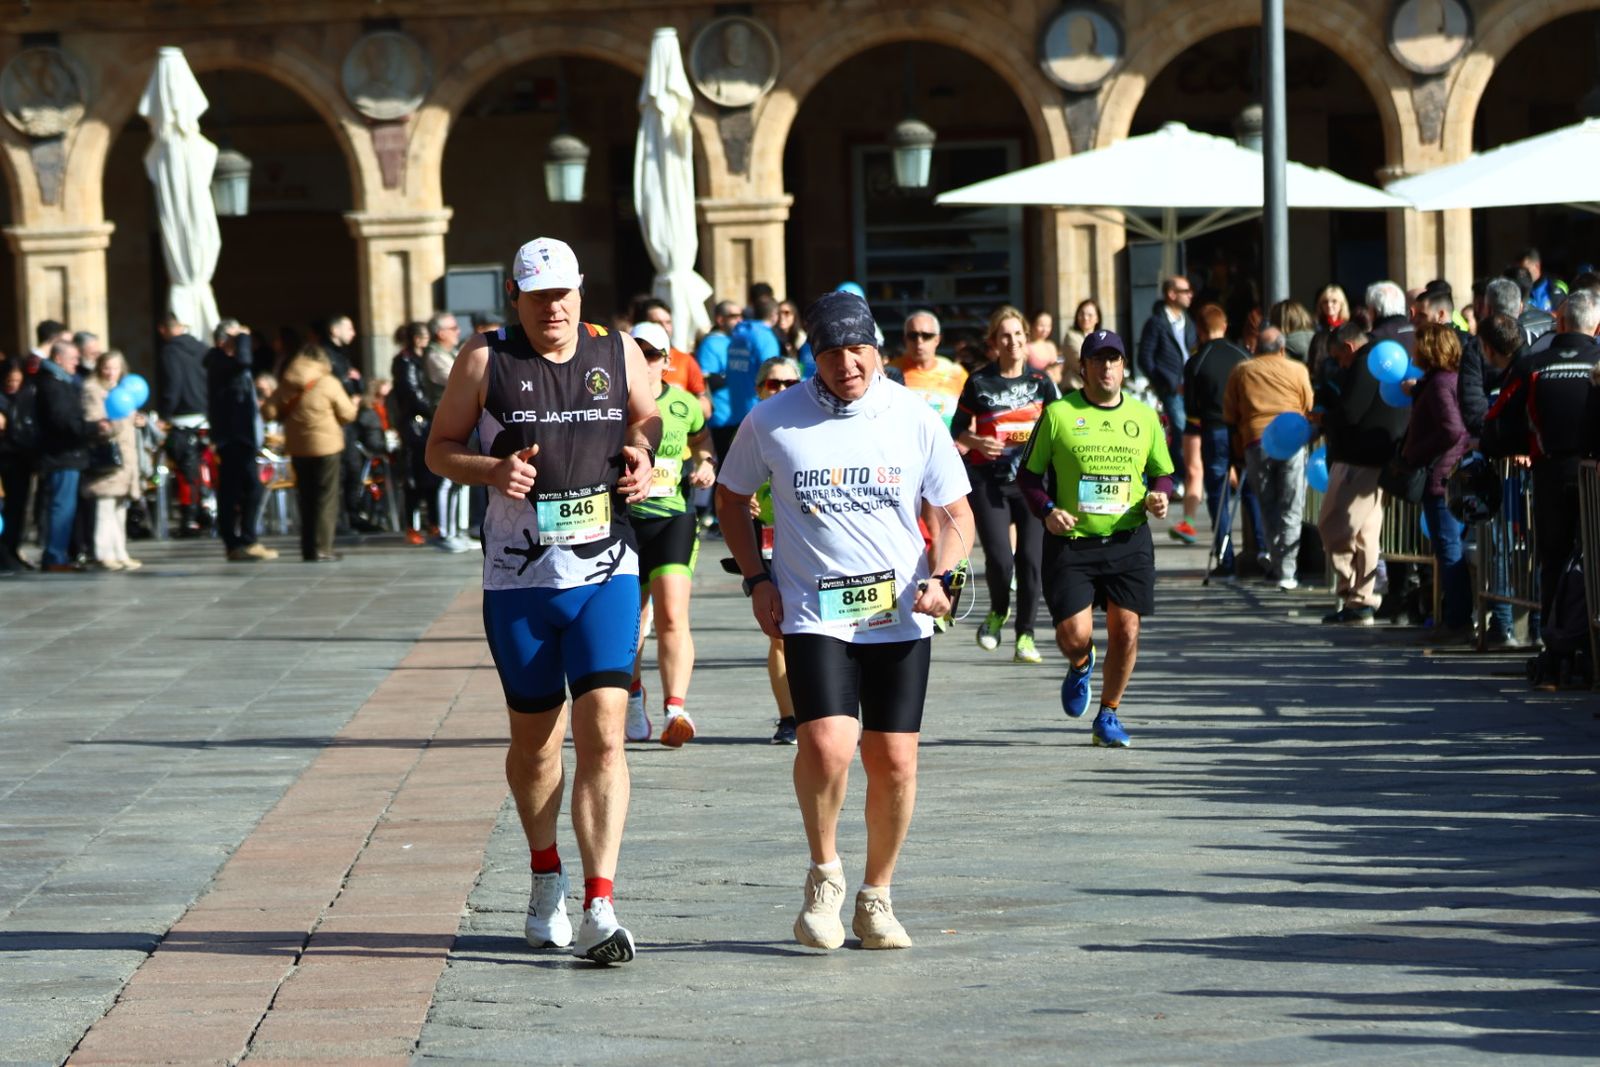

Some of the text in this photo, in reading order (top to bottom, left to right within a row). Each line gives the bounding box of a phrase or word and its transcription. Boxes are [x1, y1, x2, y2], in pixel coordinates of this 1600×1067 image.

[502, 407, 623, 424] LOS JARTIBLES
[1071, 445, 1141, 456] CORRECAMINOS
[1080, 455, 1133, 464] CARBAJOSA
[1088, 464, 1126, 472] SALAMANCA
[793, 466, 870, 489] CIRCUITO
[888, 466, 901, 475] 20
[888, 475, 901, 484] 25
[794, 488, 842, 501] CARRERAS
[1094, 484, 1119, 495] 348
[559, 499, 594, 518] 846
[842, 588, 878, 606] 848
